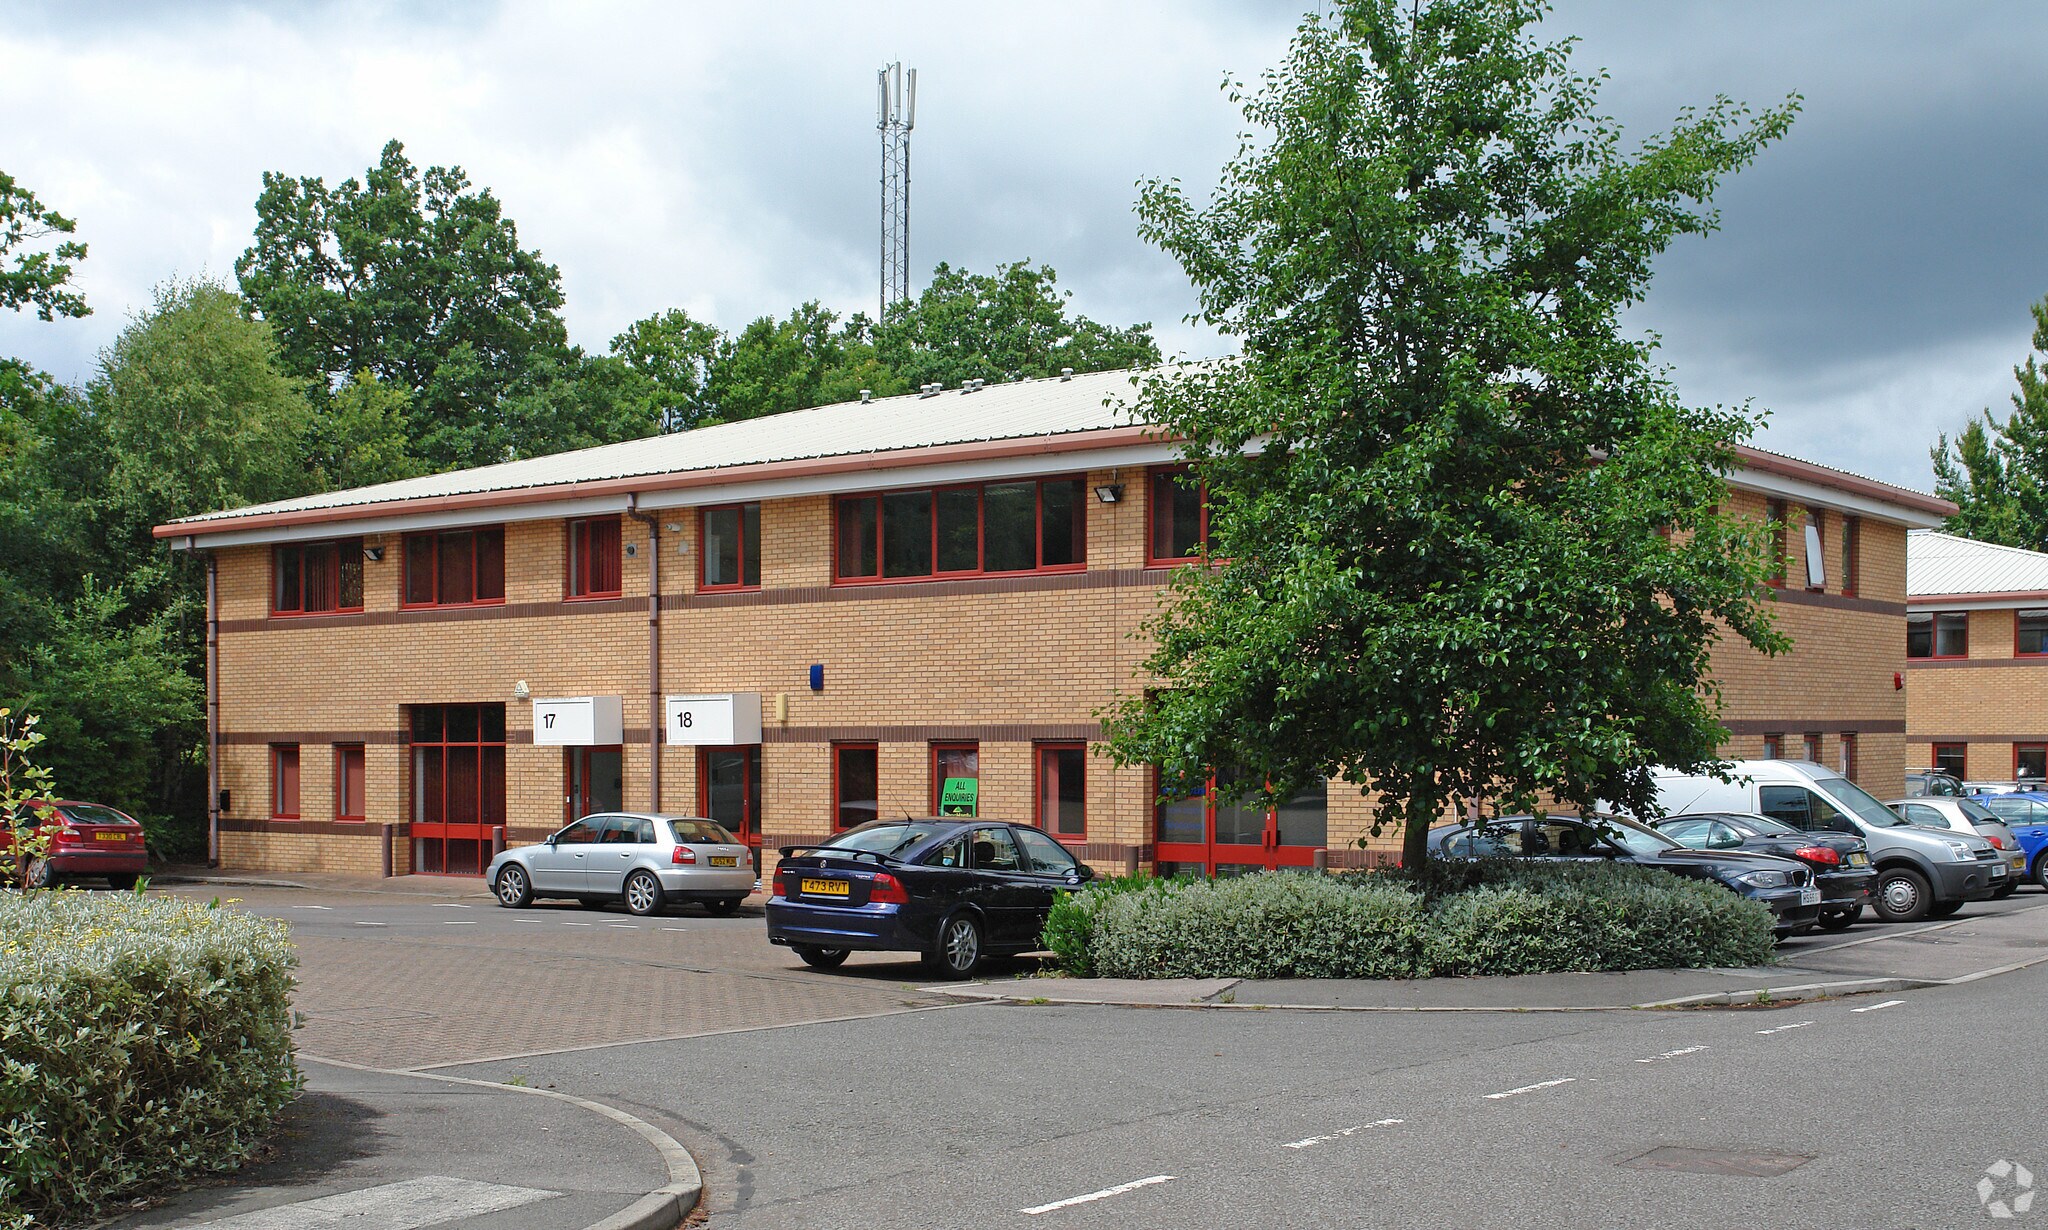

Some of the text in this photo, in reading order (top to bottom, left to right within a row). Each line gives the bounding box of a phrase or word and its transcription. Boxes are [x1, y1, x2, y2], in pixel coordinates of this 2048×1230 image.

[543, 713, 556, 729] 17
[677, 711, 693, 728] 18
[955, 781, 966, 790] ALL
[945, 793, 975, 802] ENQUIRIES
[803, 880, 848, 893] T473 RVT
